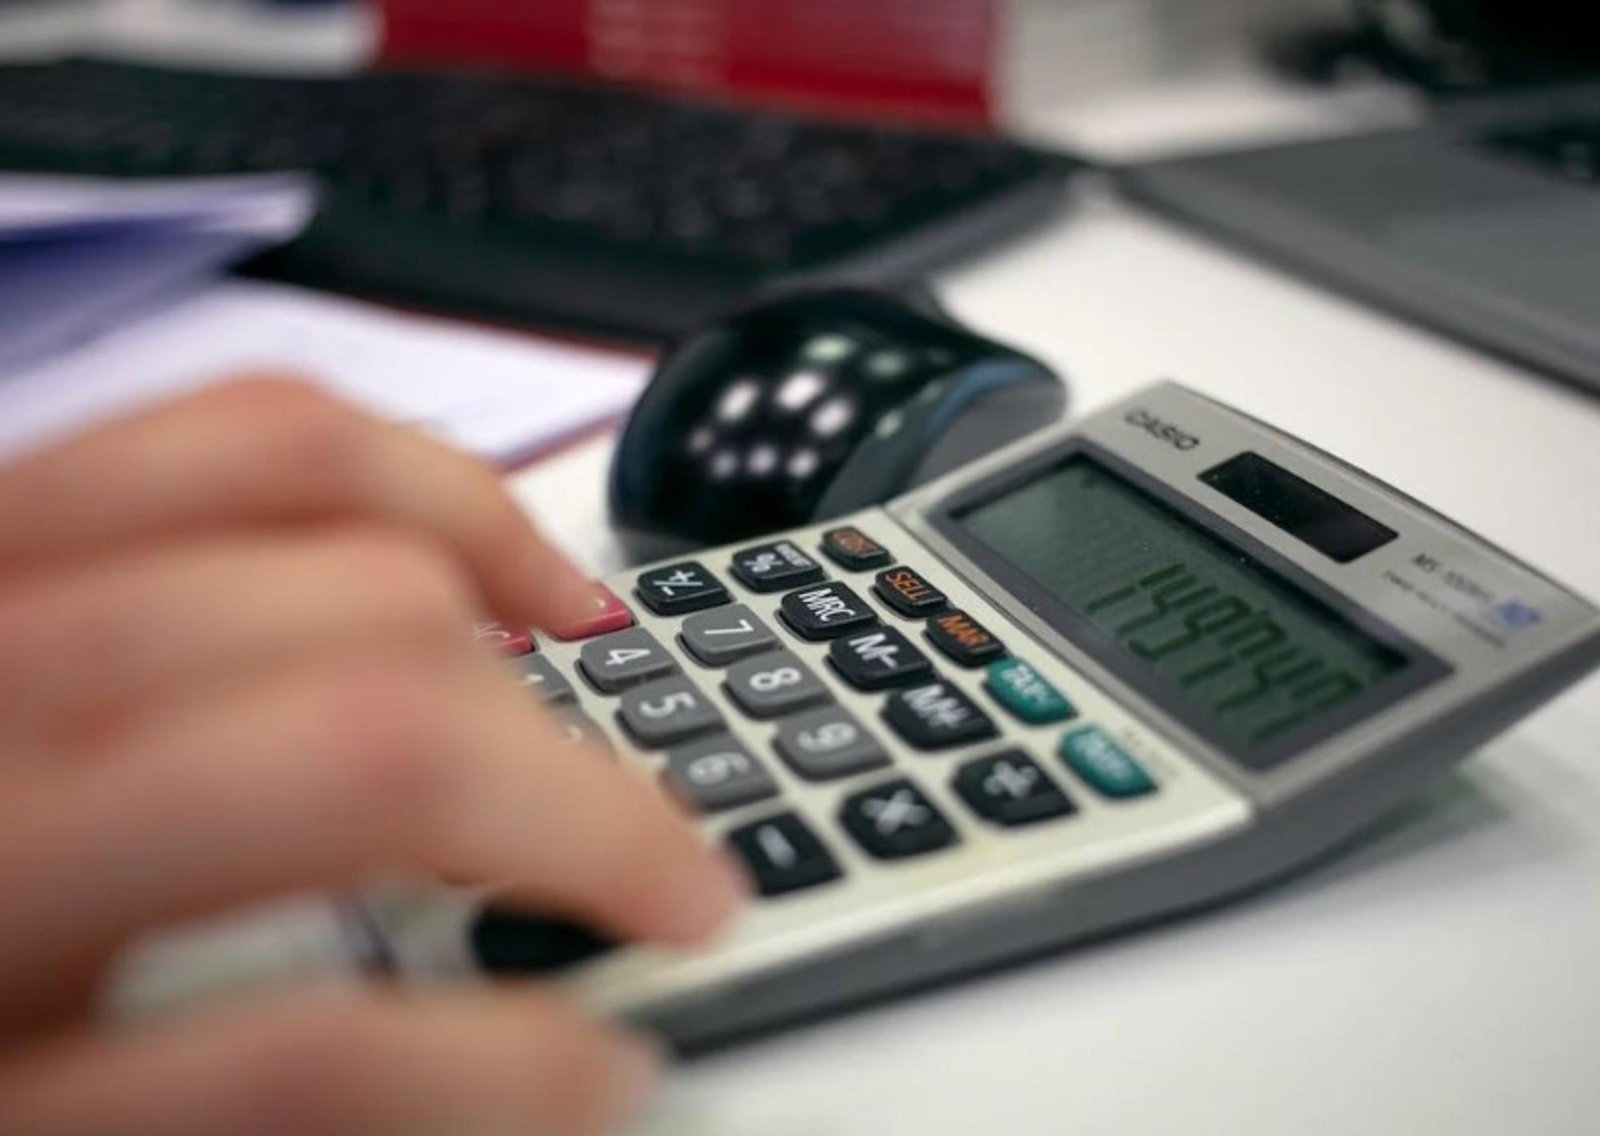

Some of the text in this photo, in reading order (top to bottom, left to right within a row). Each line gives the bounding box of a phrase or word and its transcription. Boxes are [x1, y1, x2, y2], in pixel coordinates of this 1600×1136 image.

[1125, 409, 1200, 453] CASIO
[885, 570, 932, 602] SELL
[799, 587, 855, 622] MRC
[704, 619, 753, 635] 7
[605, 648, 650, 666] 4
[750, 666, 801, 691] 8
[640, 691, 695, 718] 5
[797, 722, 858, 753] 9
[687, 751, 750, 785] 6
